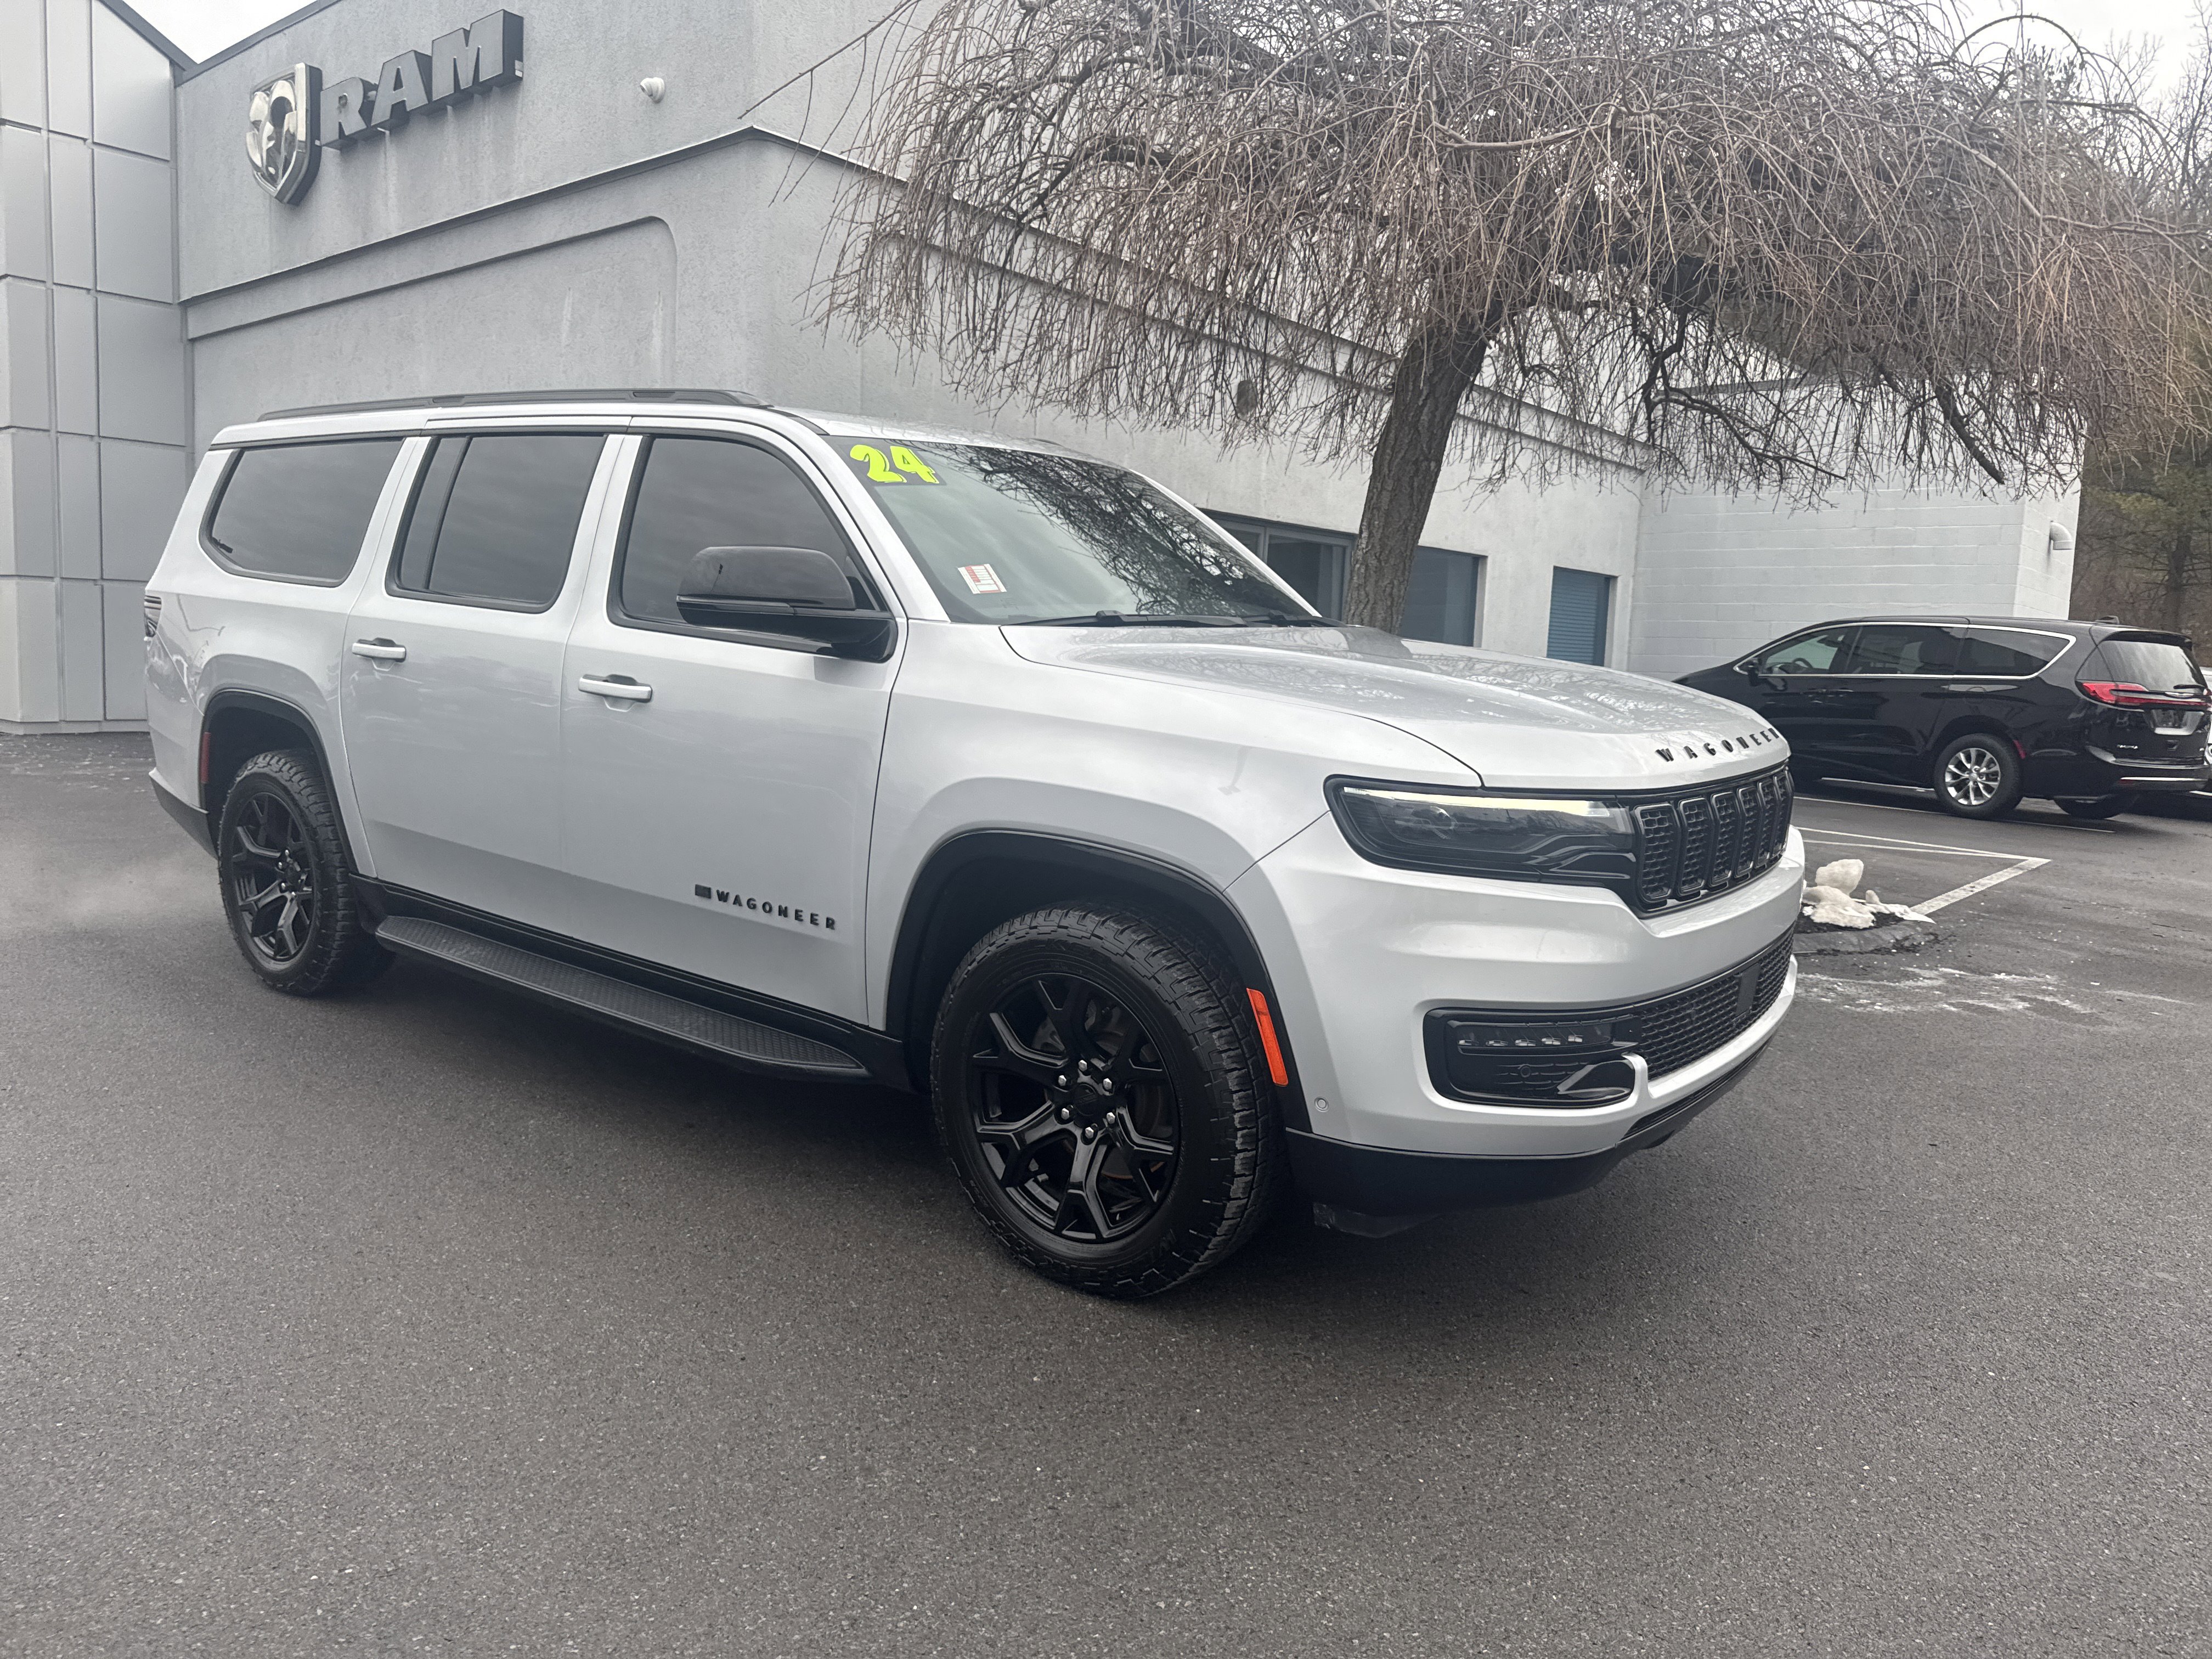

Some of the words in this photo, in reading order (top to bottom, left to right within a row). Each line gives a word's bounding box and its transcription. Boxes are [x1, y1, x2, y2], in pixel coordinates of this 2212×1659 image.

[320, 9, 523, 146] RAM
[850, 444, 939, 483] 24
[716, 889, 835, 930] WAGONEER
